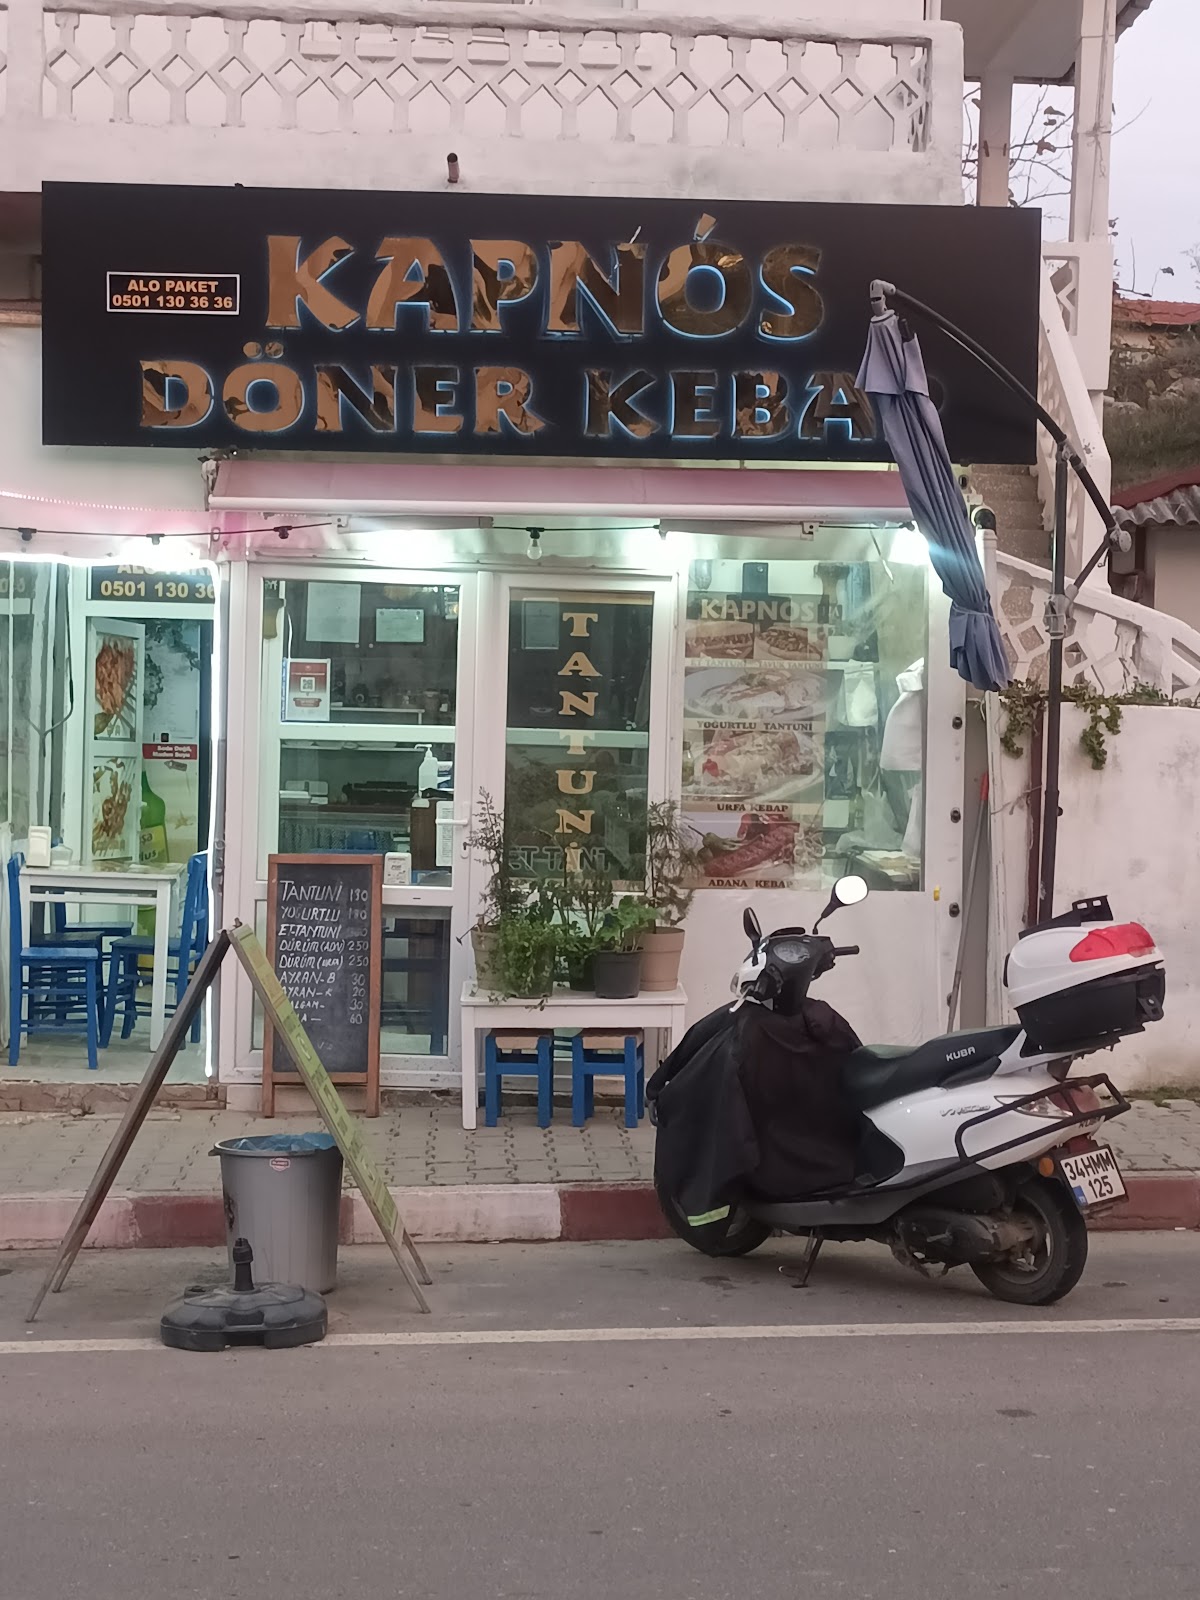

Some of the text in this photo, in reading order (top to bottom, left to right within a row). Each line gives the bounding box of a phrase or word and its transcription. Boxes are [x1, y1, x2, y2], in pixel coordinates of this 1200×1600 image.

[128, 280, 219, 293] ALO PAKET
[112, 294, 233, 309] 0501 130 36 36
[140, 341, 545, 435] DÖNER
[583, 368, 944, 440] KEBA
[100, 580, 146, 597] 0501
[154, 581, 189, 598] 130
[701, 599, 815, 621] KAPNOS
[717, 803, 789, 812] URFA KEBAP
[708, 879, 793, 889] ADANA KEBAP
[347, 940, 369, 952] 250
[348, 954, 369, 967] 250
[351, 973, 366, 986] 30
[352, 986, 366, 998] 20
[349, 998, 364, 1011] 30
[349, 1013, 363, 1025] 60
[945, 1046, 976, 1062] KUBA
[1088, 1175, 1114, 1200] 125
